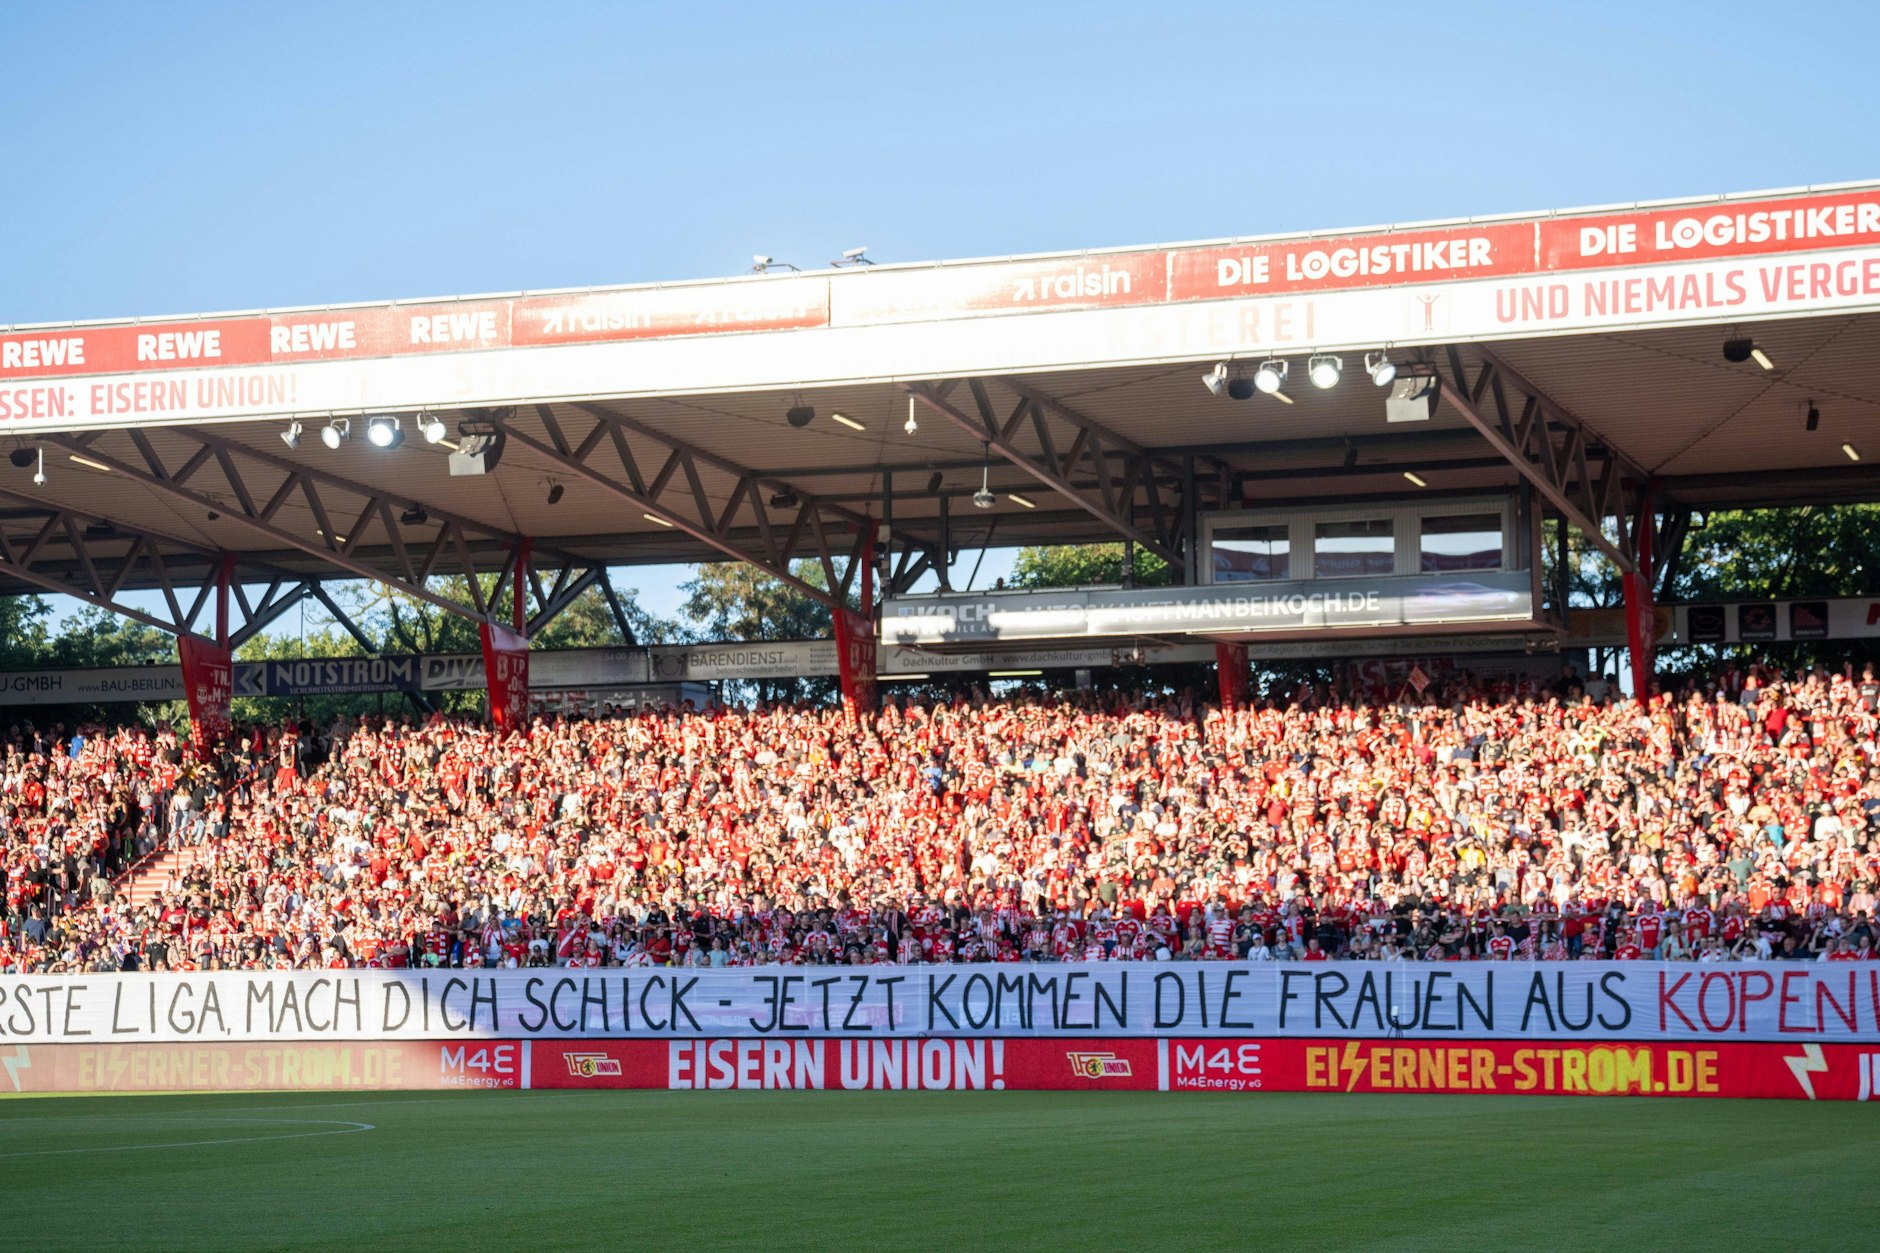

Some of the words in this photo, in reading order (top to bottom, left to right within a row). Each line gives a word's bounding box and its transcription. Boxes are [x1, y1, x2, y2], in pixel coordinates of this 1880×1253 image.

[1580, 223, 1637, 257] DIE
[1656, 203, 1880, 250] LOGISTIKER
[1217, 255, 1270, 287] DIE
[1287, 237, 1493, 281] LOGISTIKER
[1041, 265, 1131, 299] raisin
[1496, 284, 1569, 323] UND
[1584, 269, 1747, 317] NIEMALS
[1760, 258, 1880, 302] VERGE
[271, 320, 356, 354] REWE
[411, 311, 497, 344] REWE
[3, 338, 85, 368] REWE
[138, 330, 222, 362] REWE
[90, 380, 188, 415] EISERN
[197, 372, 299, 409] UNION!
[276, 659, 413, 686] NOTSTROM
[903, 656, 959, 668] DachKultur
[962, 654, 994, 665] GmbH
[112, 981, 231, 1036] LIGA,
[246, 978, 361, 1033] MACH
[382, 976, 499, 1033] DICH
[518, 975, 702, 1033] SCHICK
[718, 999, 732, 1007] -
[749, 975, 905, 1033] JETZT
[928, 971, 1127, 1030] KOMMEN
[1154, 970, 1254, 1029] DIE
[1280, 970, 1494, 1031] FRAUEN
[1520, 970, 1631, 1031] AUS
[440, 1045, 514, 1073] M4E
[596, 1060, 620, 1073] UNION
[668, 1039, 825, 1090] EISERN
[839, 1039, 1006, 1090] UNION!
[1104, 1061, 1129, 1074] UNION
[1176, 1043, 1262, 1074] M4E
[440, 1075, 500, 1088] M4Energy
[1177, 1076, 1246, 1089] M4Energy
[1249, 1078, 1262, 1087] eG
